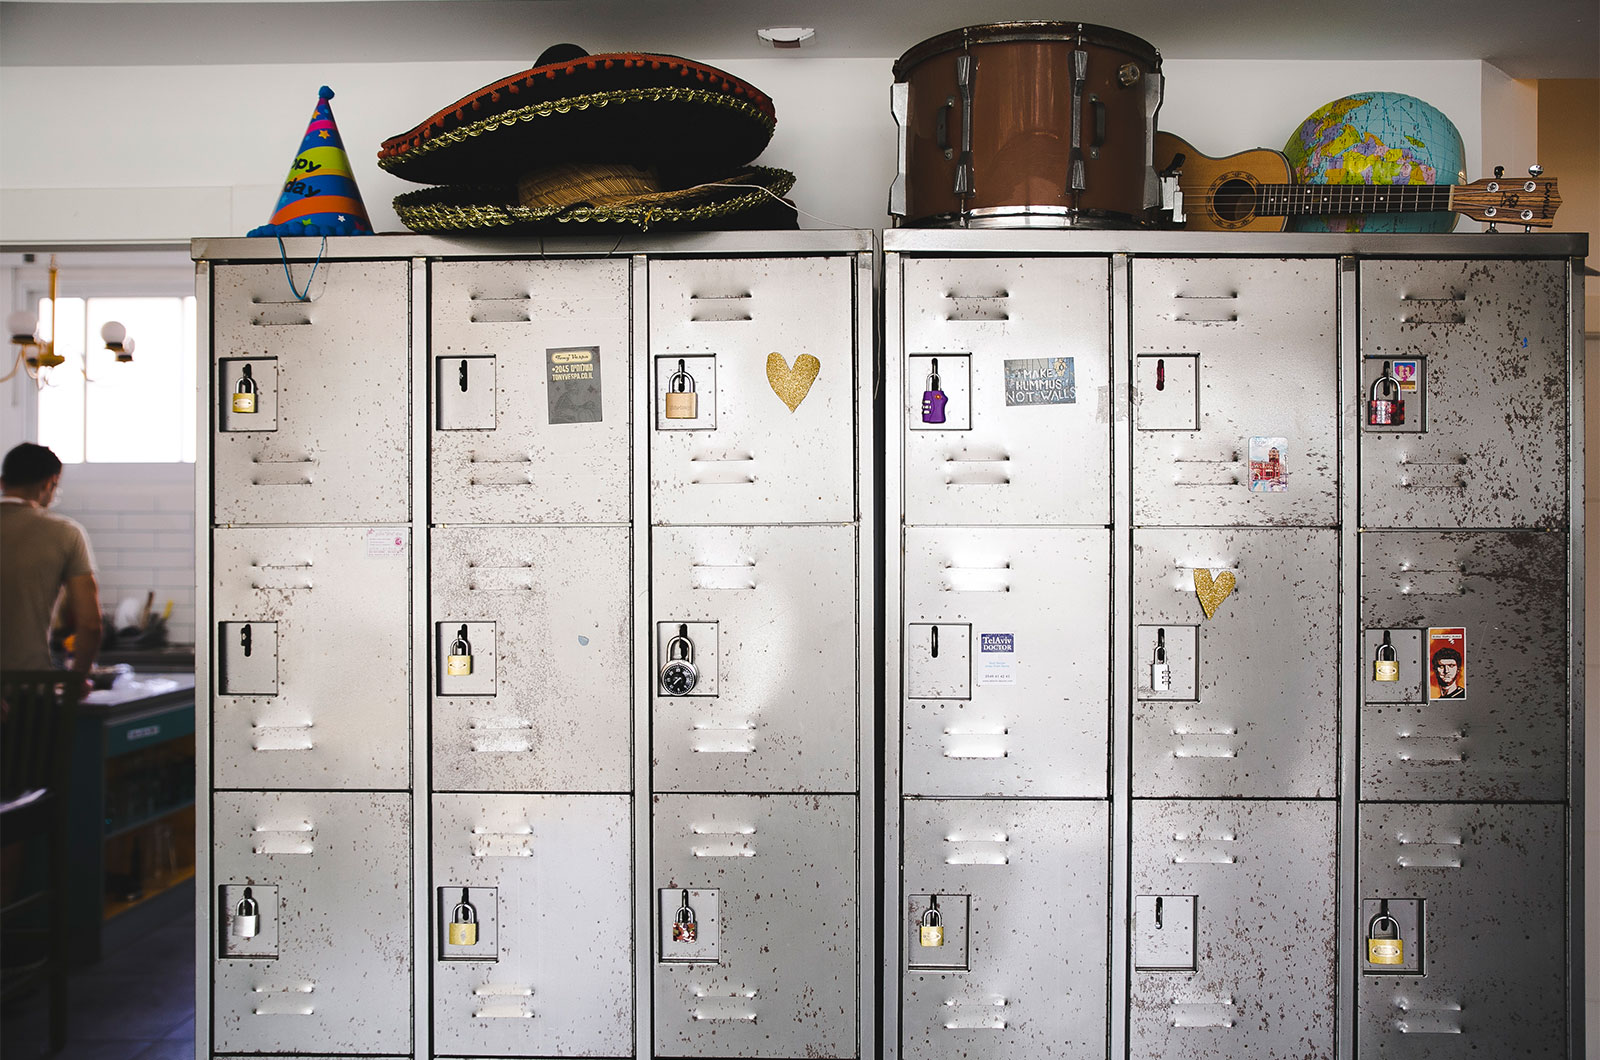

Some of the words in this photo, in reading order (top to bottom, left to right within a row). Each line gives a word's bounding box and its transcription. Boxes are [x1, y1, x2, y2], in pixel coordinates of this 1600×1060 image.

[552, 372, 593, 381] TONYVESPA.CO.IL
[1023, 368, 1054, 380] MAKE
[1015, 379, 1062, 391] HUMMUS
[1007, 391, 1035, 403] NOT
[1040, 387, 1076, 401] WALLS
